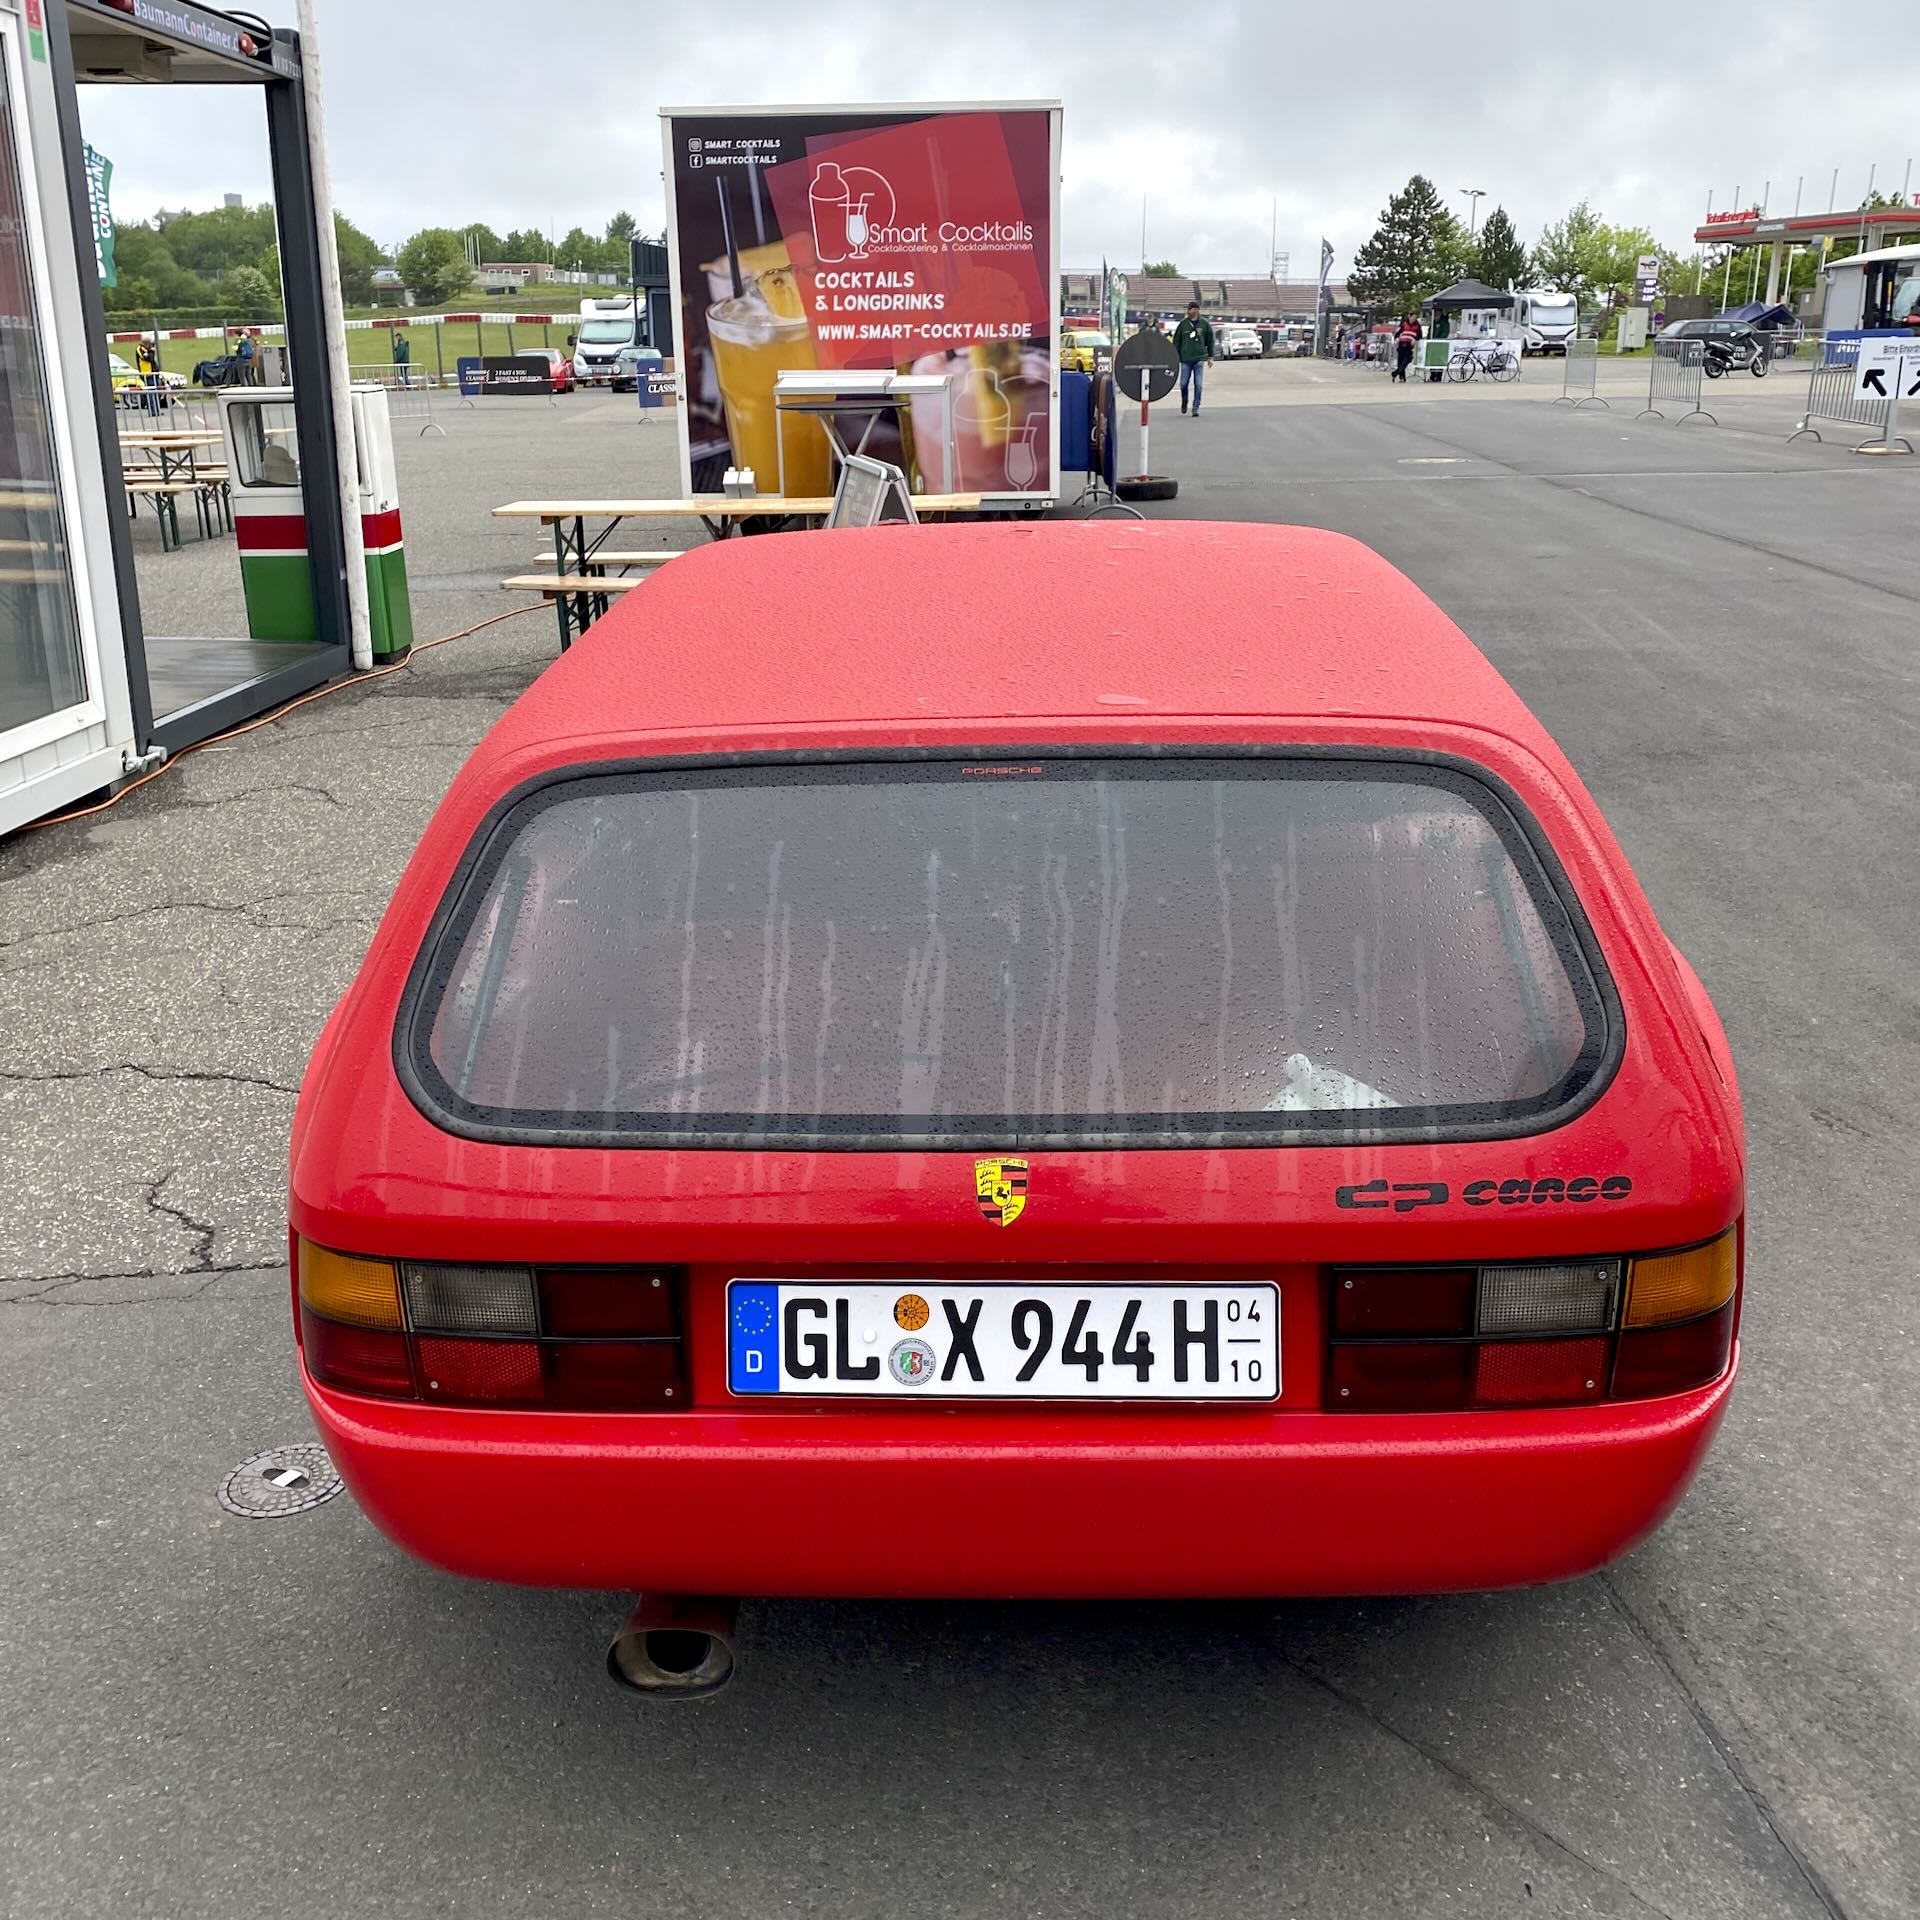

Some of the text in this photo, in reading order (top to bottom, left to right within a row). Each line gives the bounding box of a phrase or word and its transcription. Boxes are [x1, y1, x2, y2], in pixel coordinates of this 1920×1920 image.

[134, 0, 239, 52] BaumannContainer.d
[704, 139, 781, 149] SMART_COCKTAILS
[705, 155, 777, 165] SMARTCOCKTAILS
[869, 220, 1033, 244] Smart Cocktails
[867, 243, 938, 254] Cocktailcatering
[951, 242, 1033, 252] Cocktailmaschinen
[814, 271, 915, 289] COCKTAILS
[815, 293, 945, 311] & LONGDRINKS
[817, 323, 1033, 340] WWW.SMART-COCKTAILS.DE
[961, 766, 1042, 775] PORSCHE
[975, 1157, 1027, 1167] PORSCHE
[1227, 1299, 1261, 1322] 04
[745, 1350, 763, 1373] D
[784, 1298, 881, 1381] GL
[940, 1299, 985, 1382] X
[1230, 1359, 1263, 1382] 10
